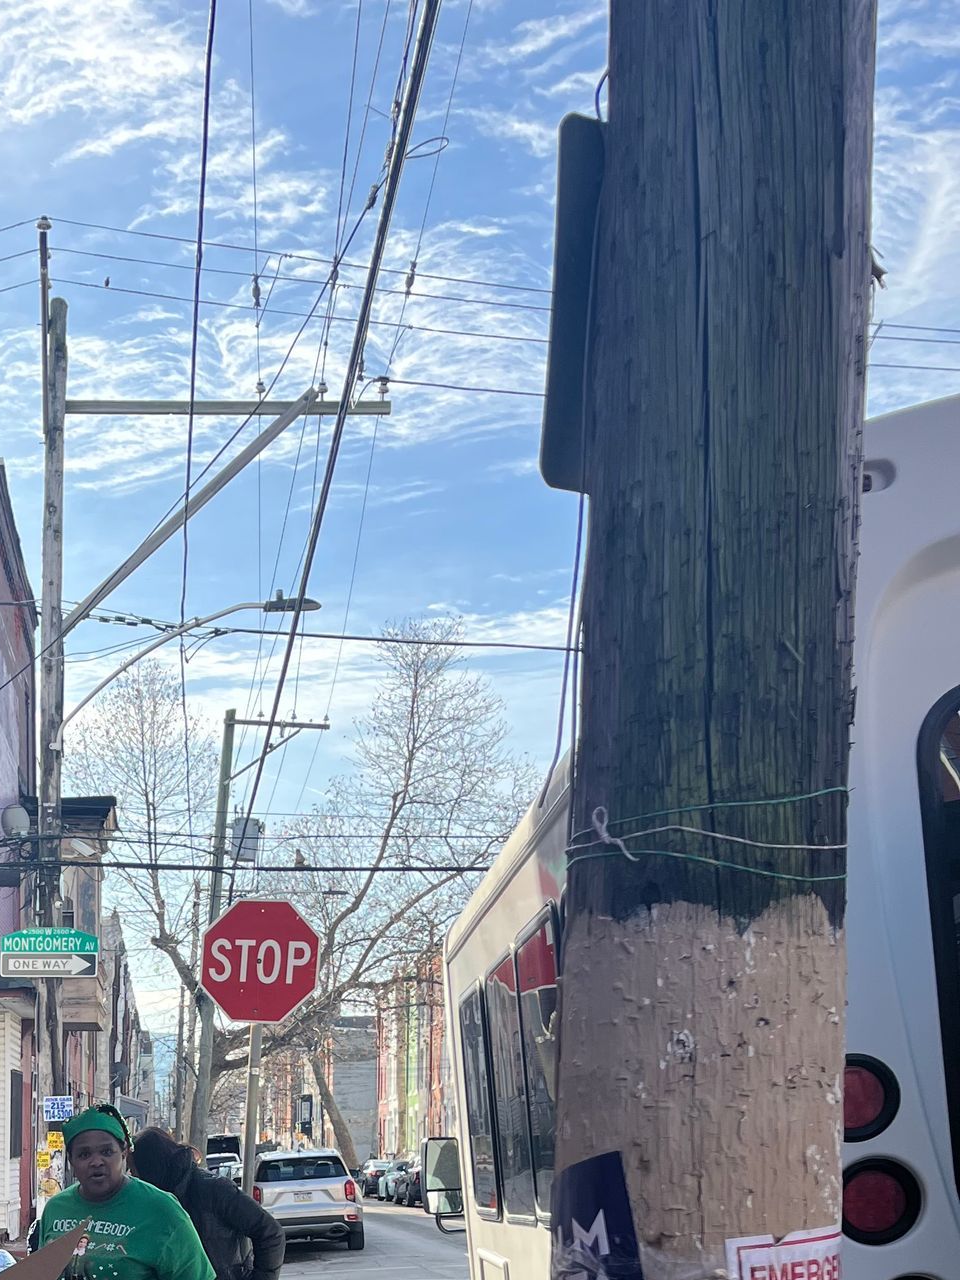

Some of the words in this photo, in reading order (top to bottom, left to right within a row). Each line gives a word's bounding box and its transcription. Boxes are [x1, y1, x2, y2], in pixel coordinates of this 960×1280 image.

[3, 937, 82, 951] MONTGOMERY
[84, 942, 95, 951] AV
[13, 960, 39, 969] ONE
[42, 960, 68, 969] WAY
[208, 938, 311, 984] STOP
[79, 1219, 136, 1236] OMEBODY
